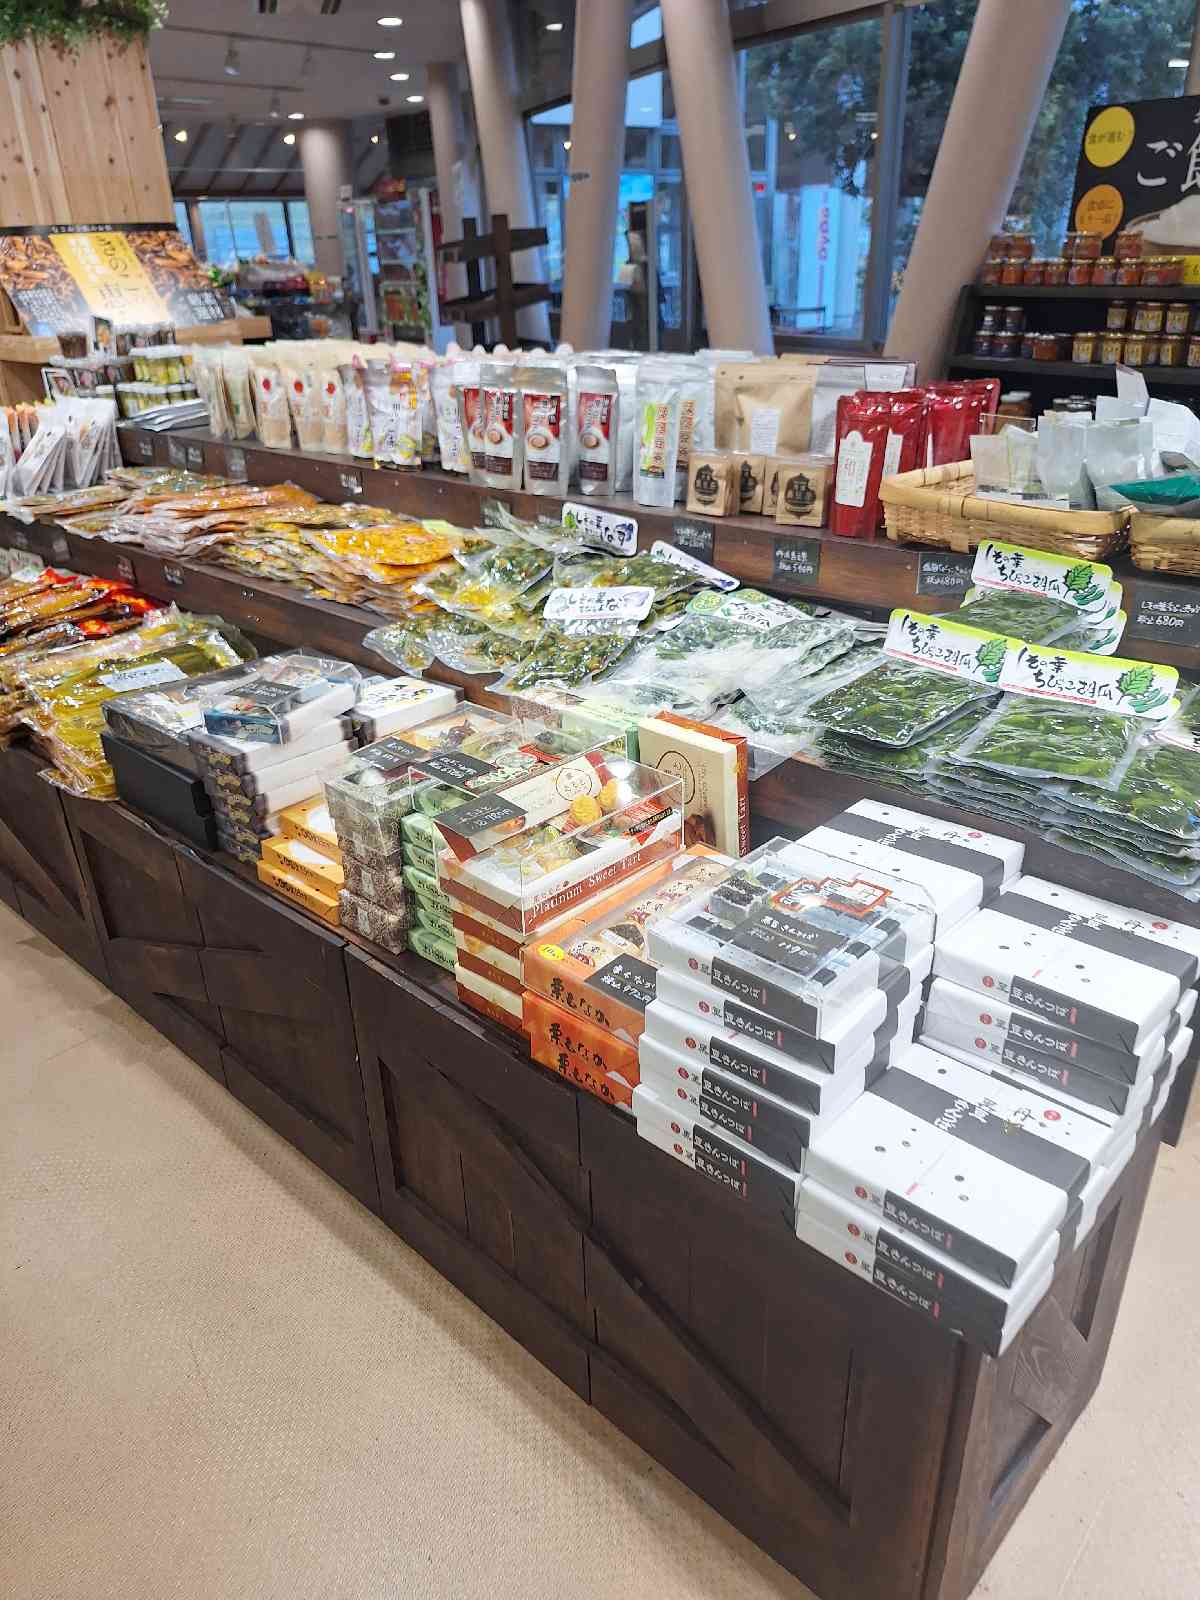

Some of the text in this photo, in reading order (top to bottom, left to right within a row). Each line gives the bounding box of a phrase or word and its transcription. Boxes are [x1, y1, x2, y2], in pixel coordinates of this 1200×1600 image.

[528, 852, 642, 924] Platinum Sweet Tart
